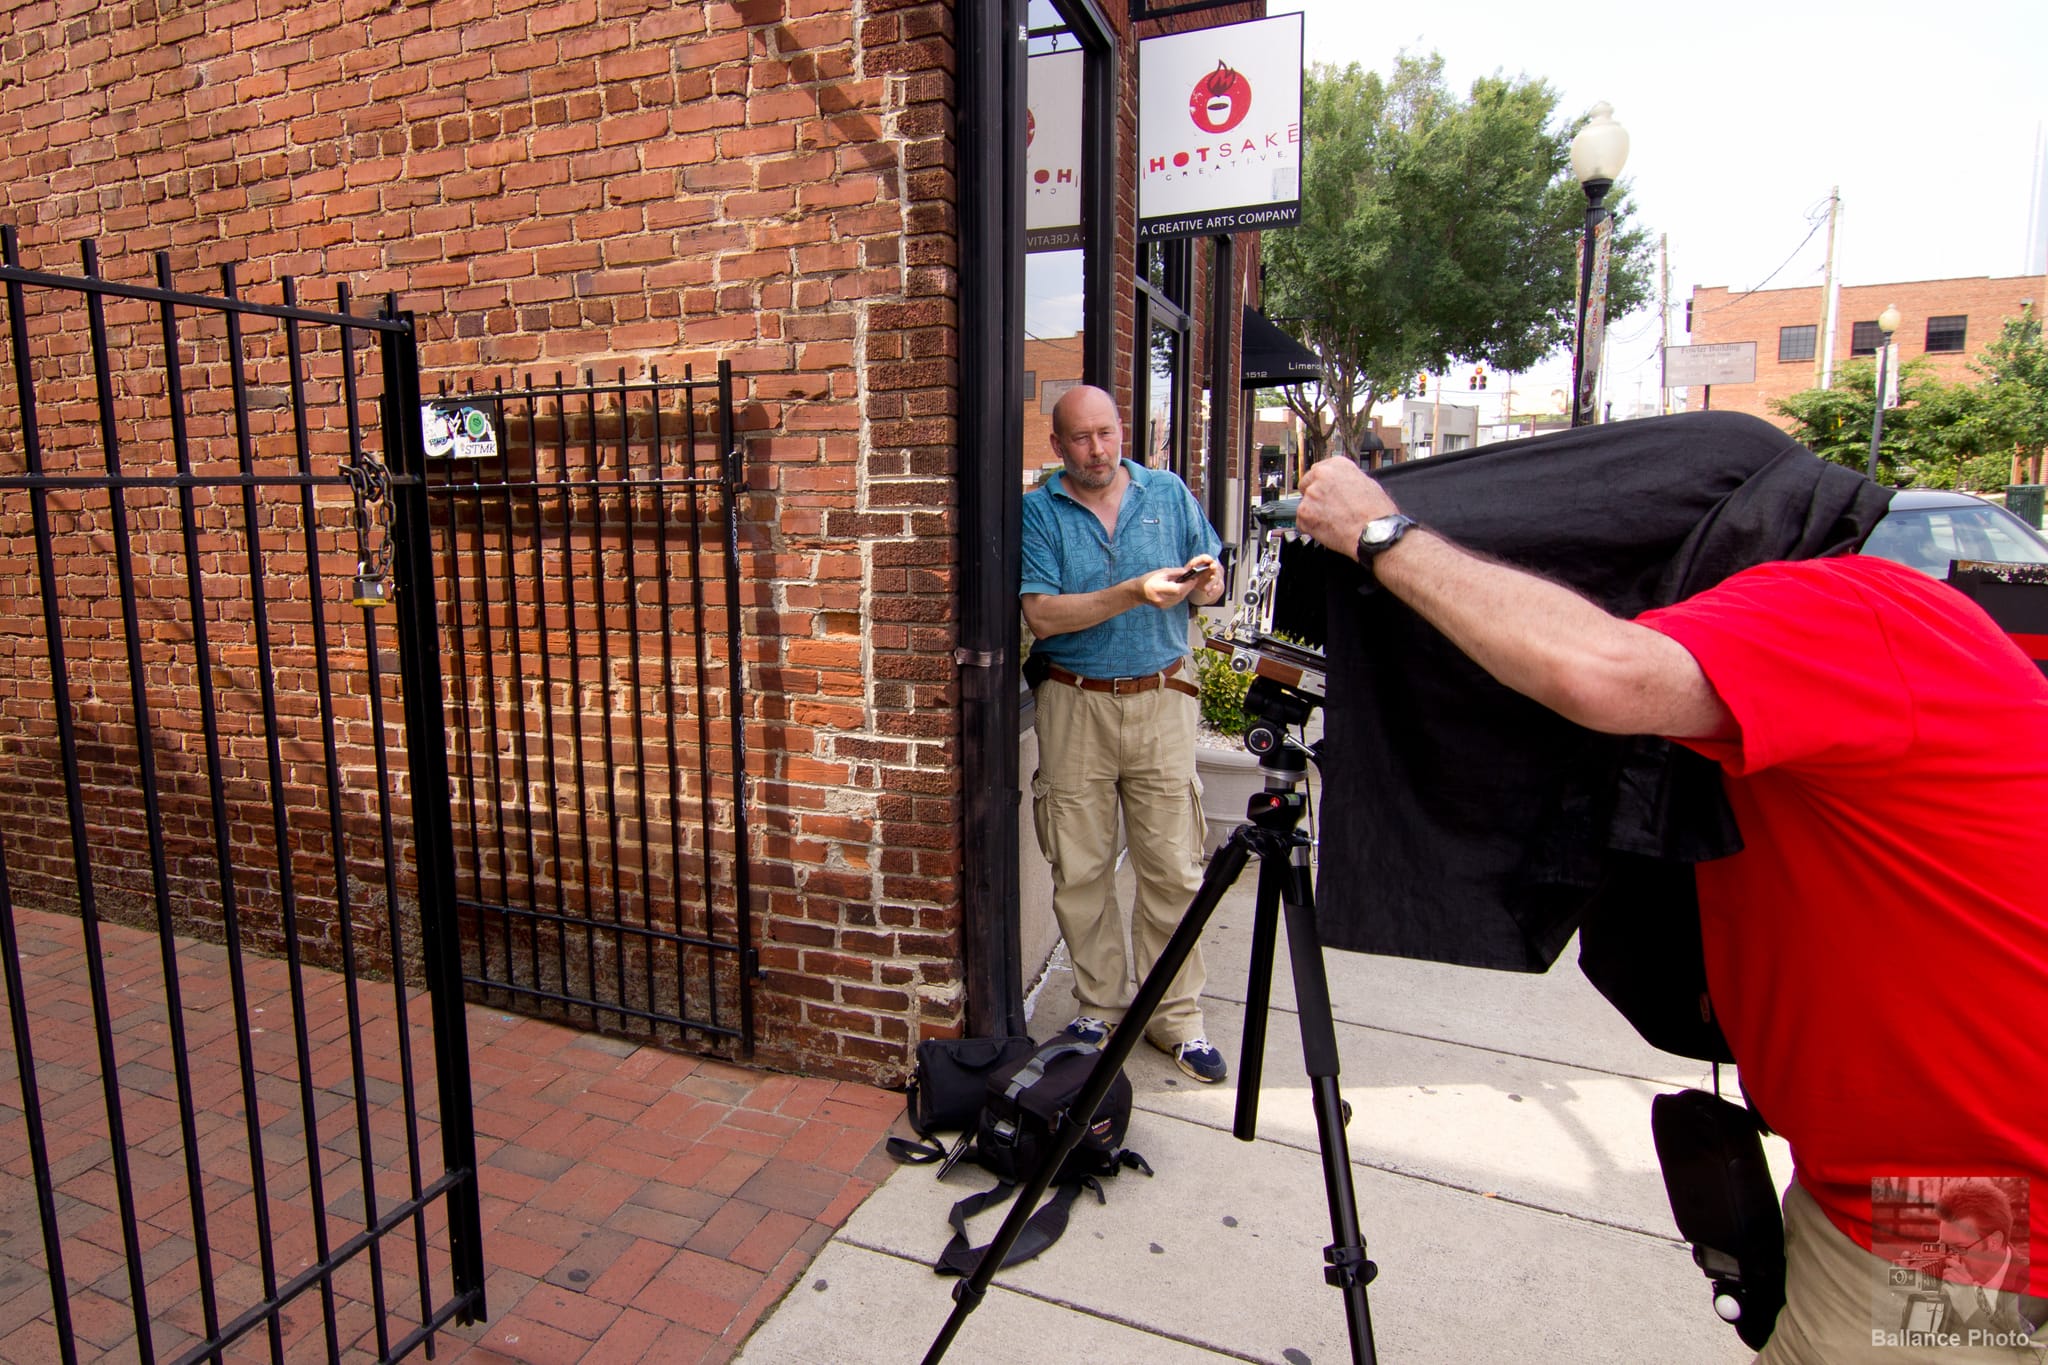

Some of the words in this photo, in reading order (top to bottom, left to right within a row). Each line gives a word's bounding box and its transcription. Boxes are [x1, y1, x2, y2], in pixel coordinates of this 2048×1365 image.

[1165, 151, 1284, 181] CREATIVE
[1140, 225, 1149, 236] A
[1151, 218, 1203, 235] CREATIVE
[1206, 215, 1235, 228] ARTS
[1238, 208, 1297, 225] COMPANY
